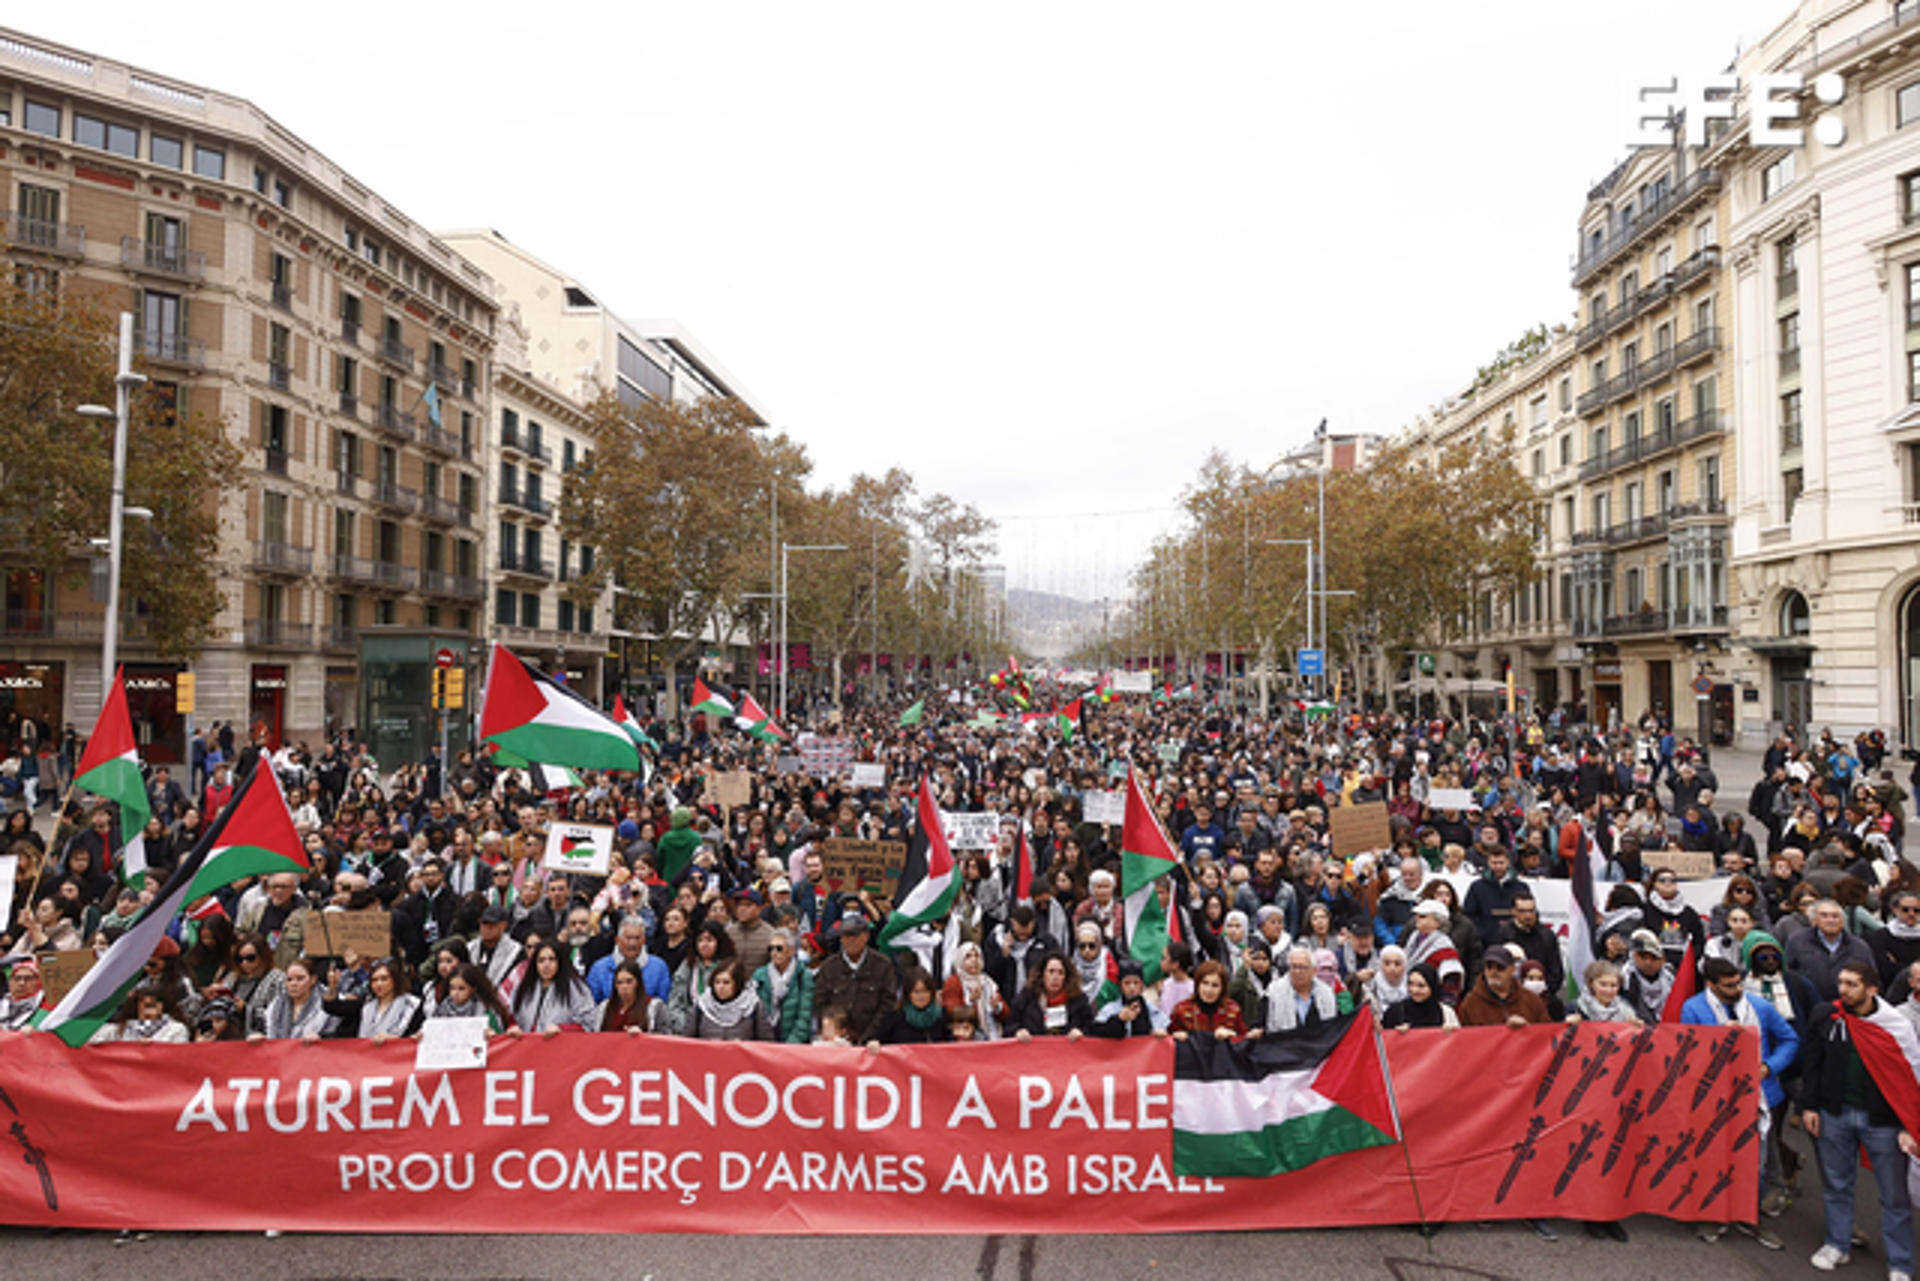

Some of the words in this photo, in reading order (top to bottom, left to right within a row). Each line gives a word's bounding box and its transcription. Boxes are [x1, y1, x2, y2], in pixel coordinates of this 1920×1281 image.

[175, 1072, 461, 1133] ATUREM
[483, 1070, 549, 1127] EL
[573, 1072, 923, 1130] GENOCIDI
[947, 1074, 997, 1129] A
[1018, 1073, 1170, 1131] PALE
[339, 1151, 475, 1192] PROU
[492, 1148, 703, 1206] COMERÇ
[941, 1152, 1050, 1195] AMB
